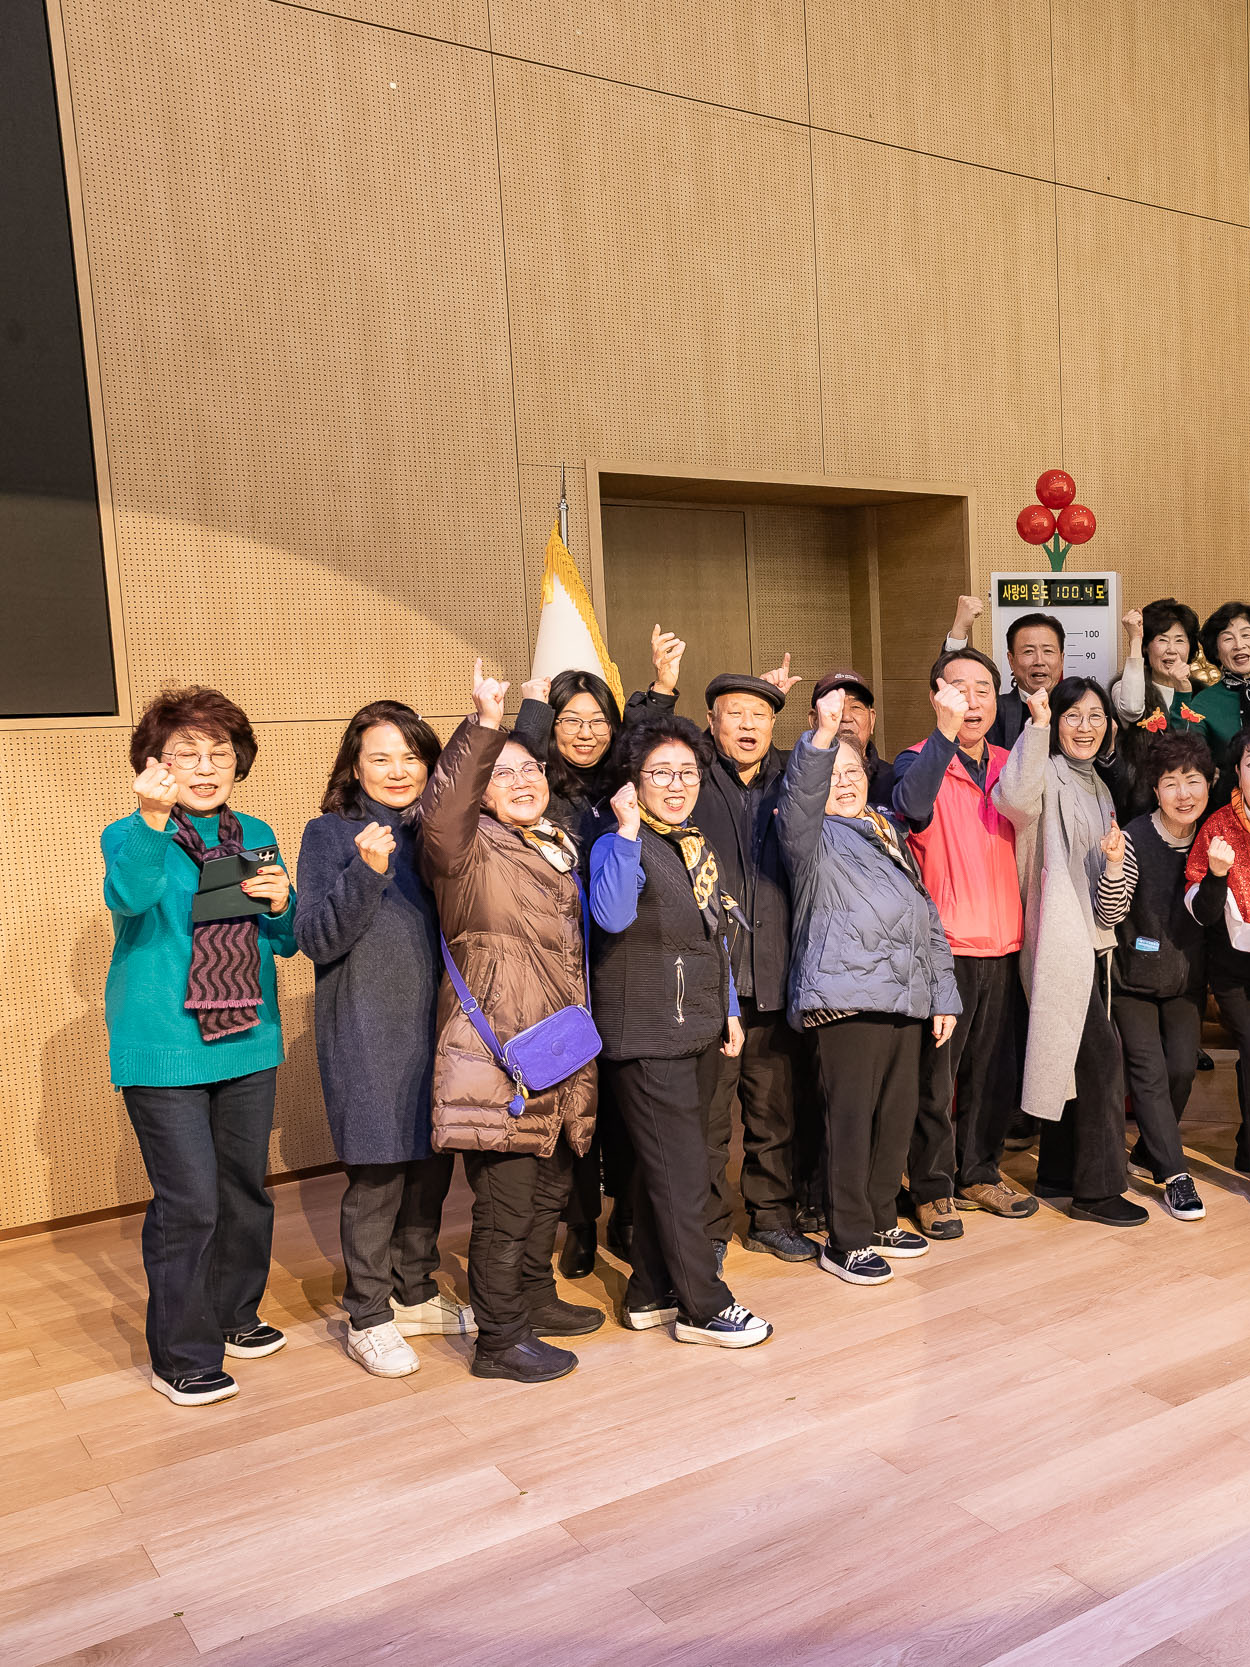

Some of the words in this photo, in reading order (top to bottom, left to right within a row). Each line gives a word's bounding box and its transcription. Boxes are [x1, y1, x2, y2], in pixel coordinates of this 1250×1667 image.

[1002, 584, 1028, 600] 사랑의
[1084, 630, 1100, 638] 100
[1085, 652, 1096, 660] 90
